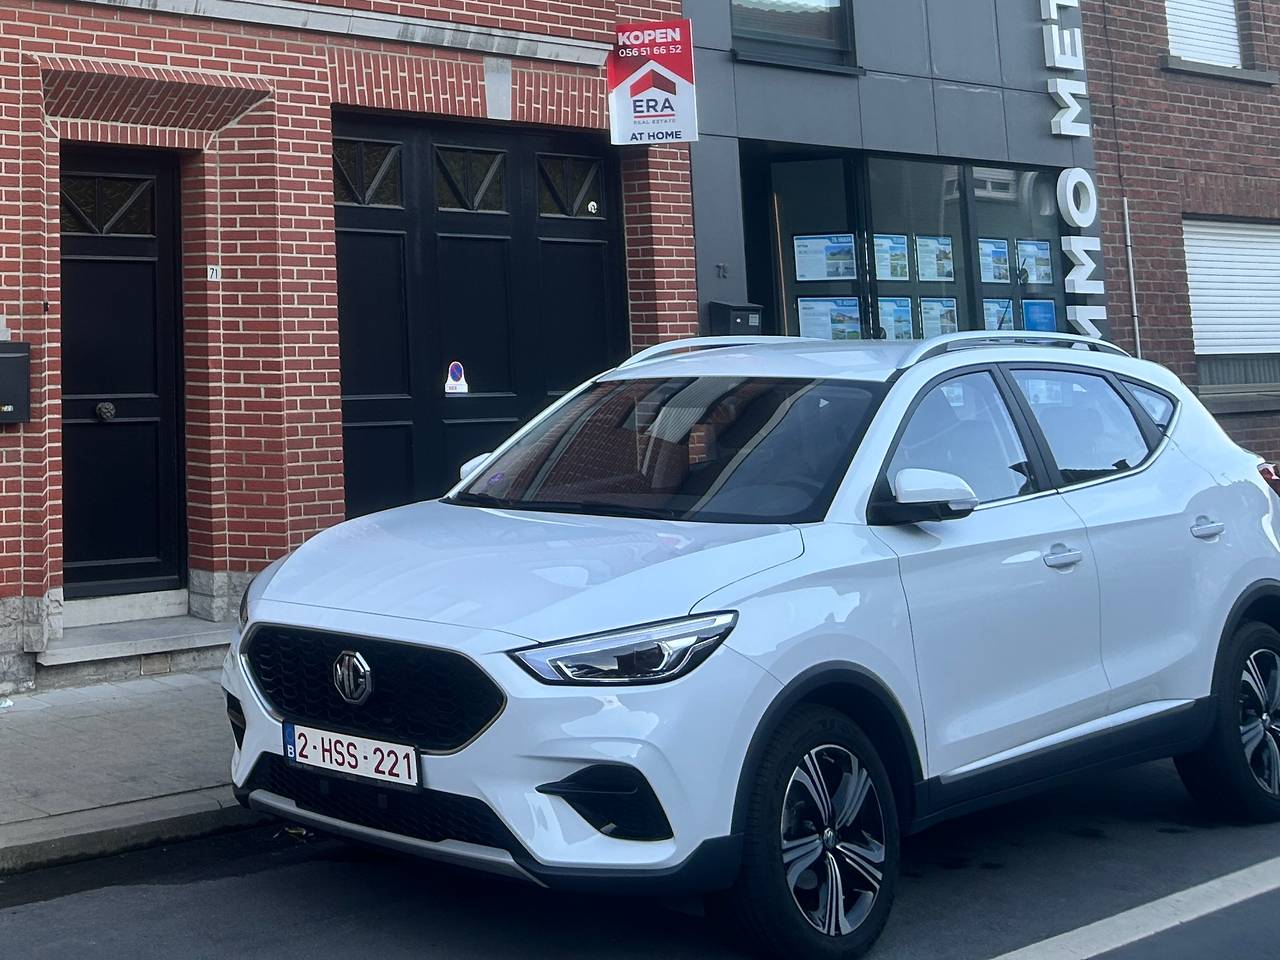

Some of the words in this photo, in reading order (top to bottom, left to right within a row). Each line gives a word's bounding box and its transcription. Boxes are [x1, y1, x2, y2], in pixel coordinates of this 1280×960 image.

[618, 27, 681, 46] KOPEN
[618, 48, 639, 57] 056
[640, 47, 650, 56] 51
[653, 46, 667, 55] 66
[669, 45, 682, 54] 52
[632, 98, 675, 113] ERA
[630, 132, 644, 141] AT
[647, 130, 682, 140] HOME
[1056, 167, 1108, 351] MMO
[209, 267, 218, 279] 71
[287, 744, 296, 758] B
